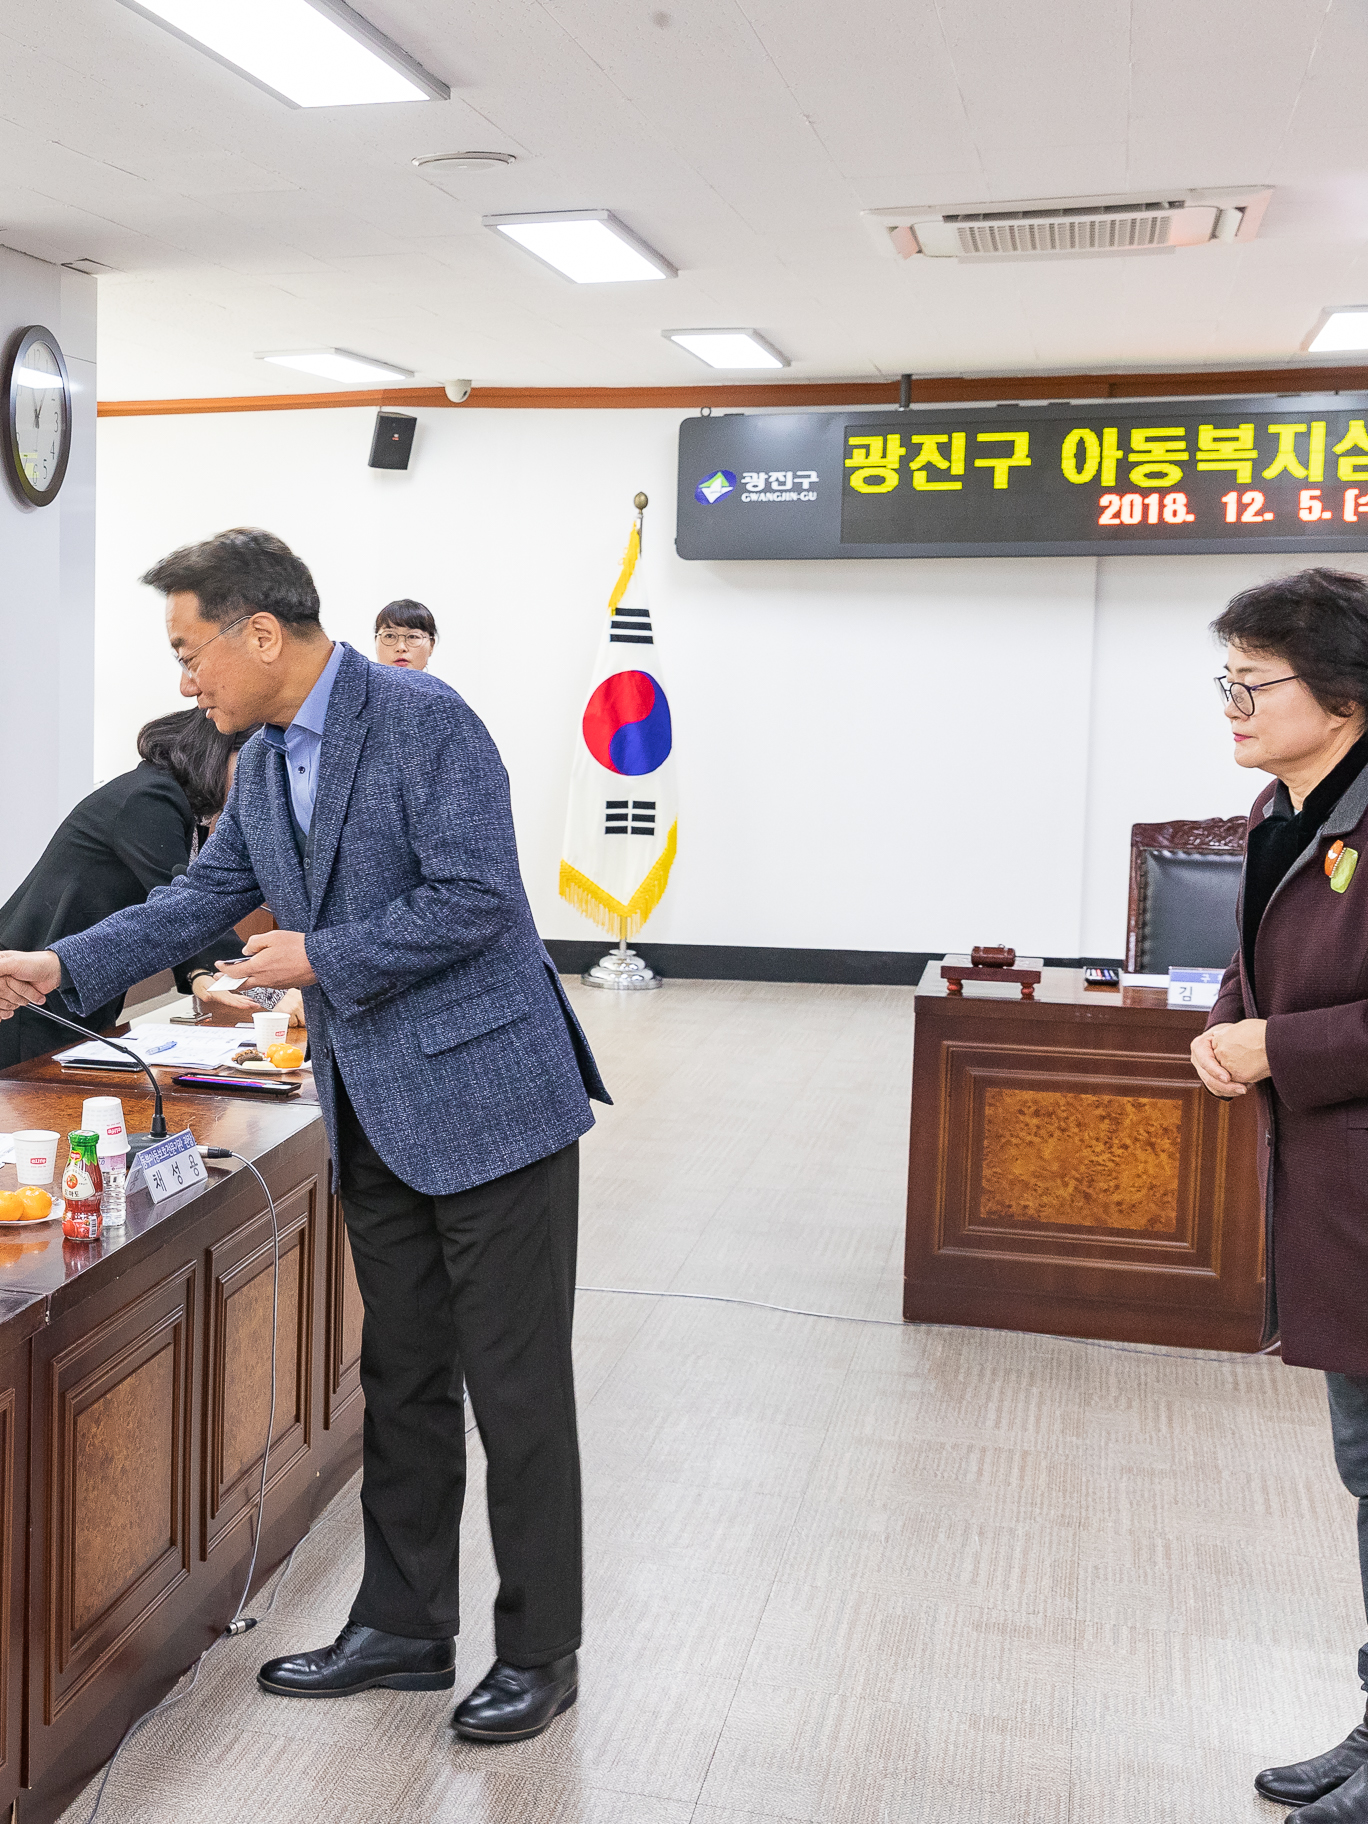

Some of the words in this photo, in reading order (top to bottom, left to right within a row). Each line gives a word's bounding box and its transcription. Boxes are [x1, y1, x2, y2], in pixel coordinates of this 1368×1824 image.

[844, 431, 1032, 493] 광진구
[740, 470, 820, 492] 광진구
[740, 491, 818, 503] GWANGJIN-GU
[1098, 492, 1196, 526] 2018.
[1221, 489, 1275, 523] 12.
[1298, 488, 1333, 522] 5.
[1179, 986, 1192, 1002] 김
